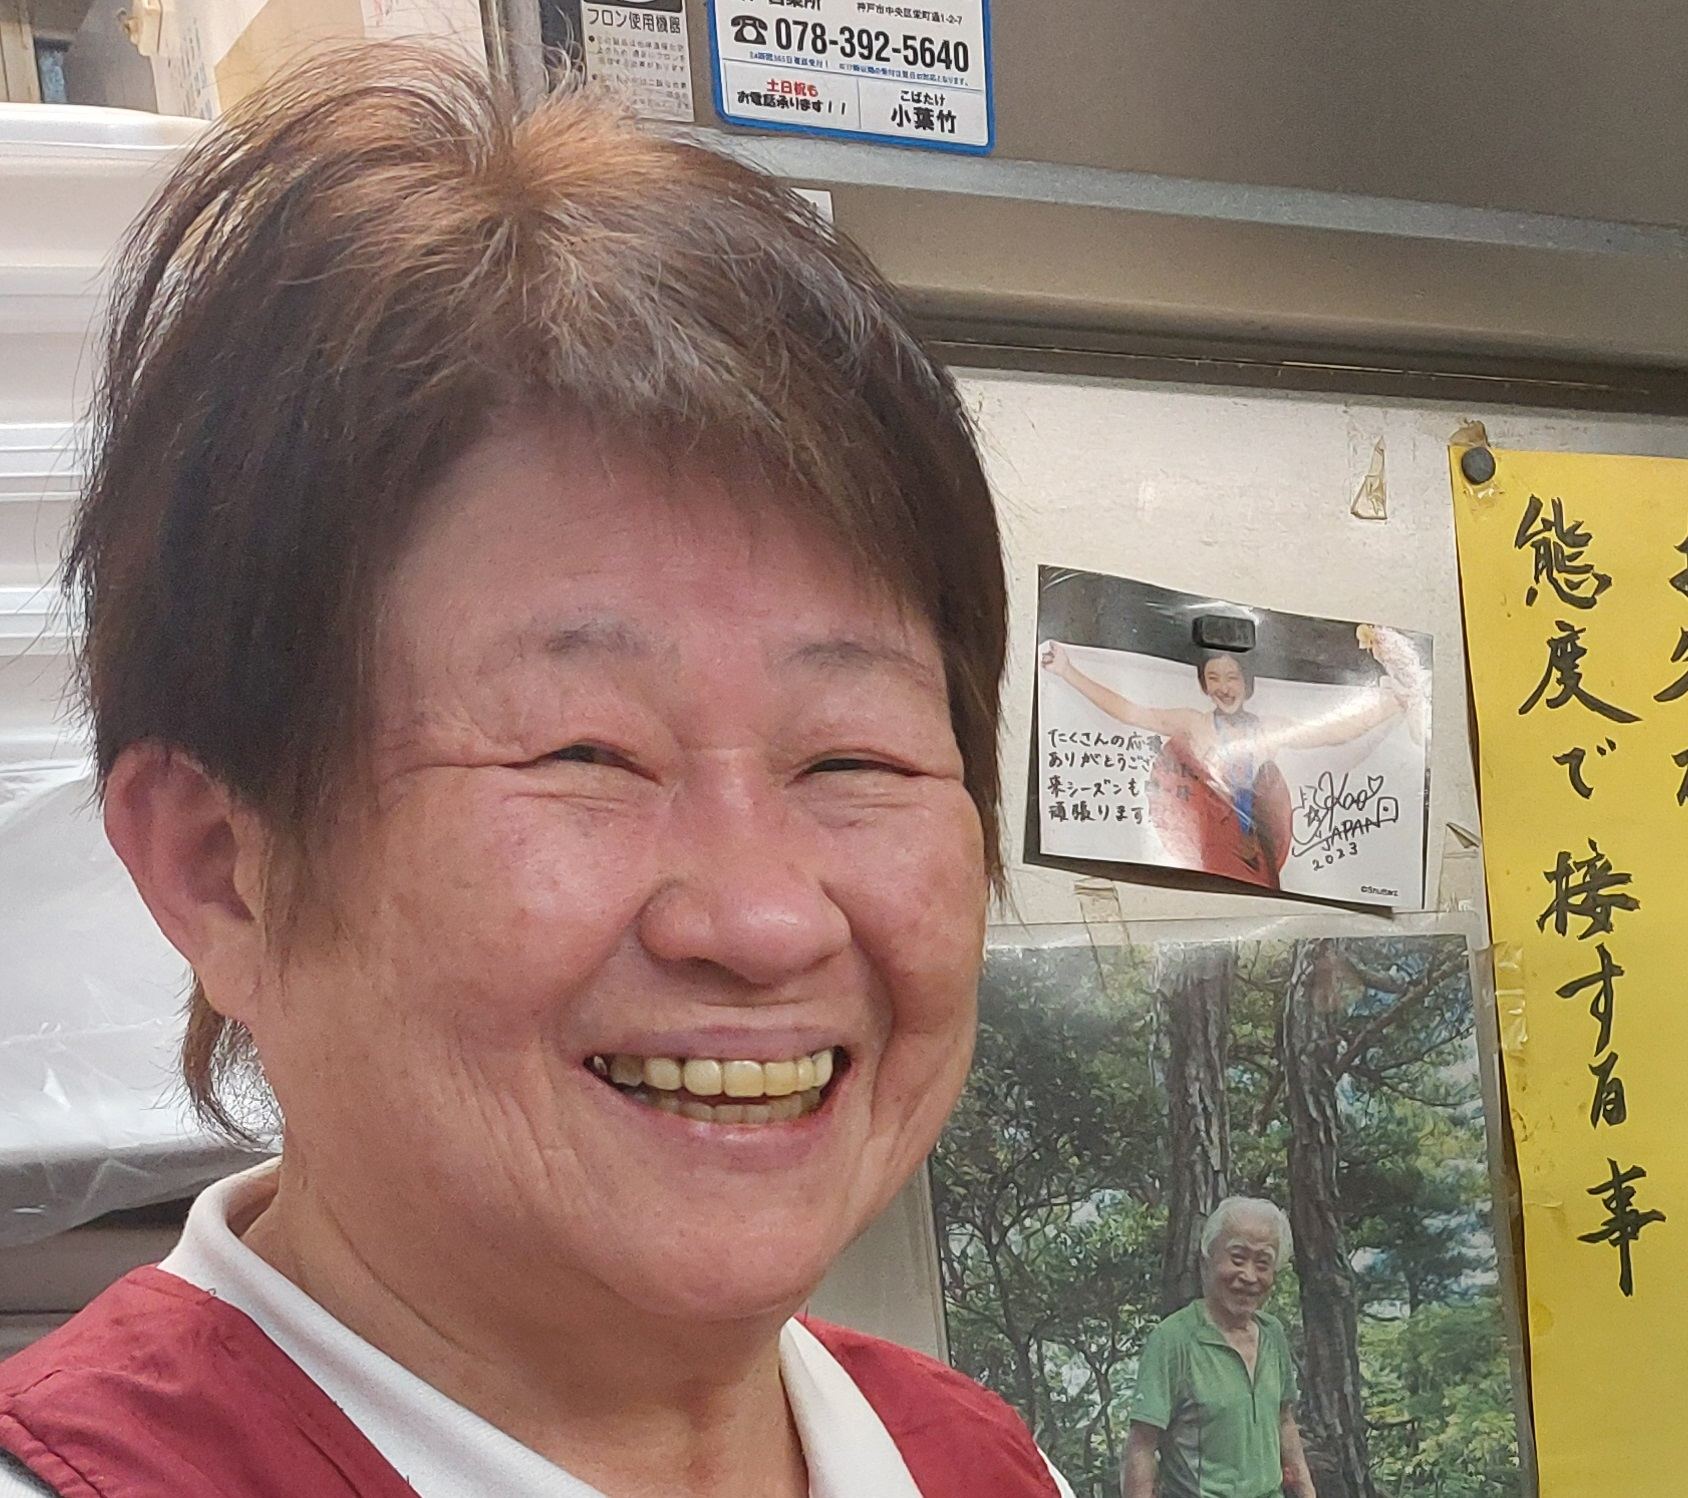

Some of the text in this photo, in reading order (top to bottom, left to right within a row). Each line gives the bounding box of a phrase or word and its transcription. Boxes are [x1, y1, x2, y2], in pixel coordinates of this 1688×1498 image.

[587, 8, 681, 34] フロン使用機器
[775, 17, 969, 73] 078-392-5640
[766, 78, 819, 98] 土日祝も
[900, 90, 946, 106] こばたけ
[891, 104, 956, 134] 小葉竹
[1049, 801, 1144, 825] 頑張ります
[1312, 841, 1359, 872] 2023
